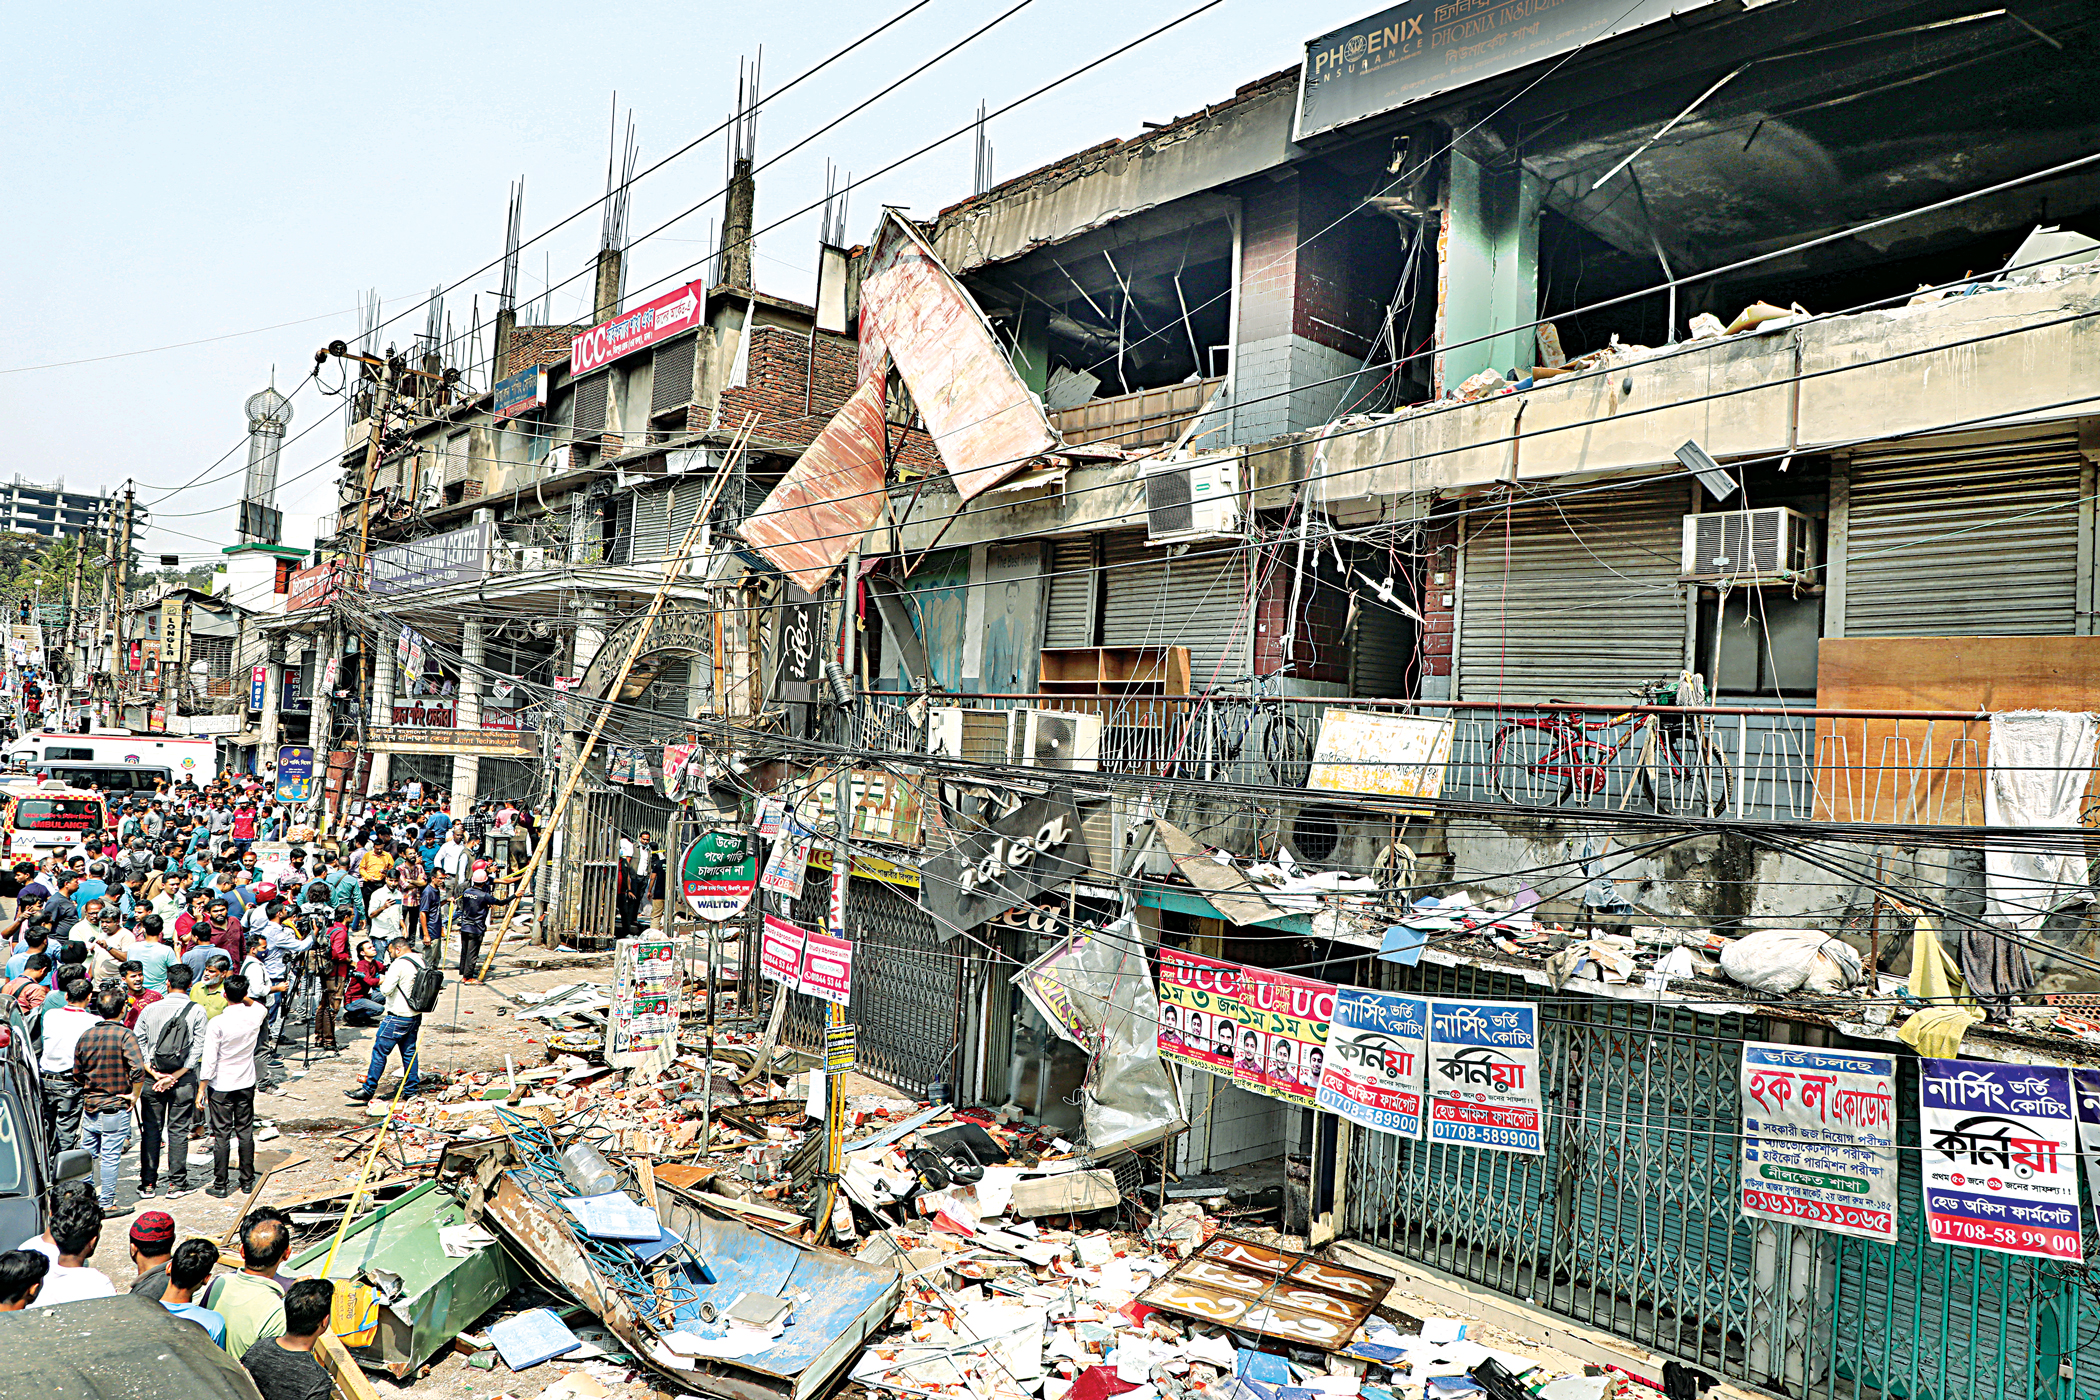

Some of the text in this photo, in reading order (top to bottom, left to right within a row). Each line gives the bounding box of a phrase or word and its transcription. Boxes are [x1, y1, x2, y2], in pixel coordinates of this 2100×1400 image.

[1315, 13, 1424, 75] PHOENIX
[1431, 13, 1496, 49] PHOENIX
[1511, 21, 1541, 41] শাখা
[1315, 39, 1422, 85] NSURANCE
[571, 326, 606, 373] UCC
[447, 528, 480, 567] CENTER
[997, 552, 1039, 569] The Best Tailors
[784, 610, 814, 678] idea
[30, 820, 89, 829] AMBULANCE
[715, 835, 742, 849] উল্টো
[958, 814, 1072, 895] idea
[698, 865, 745, 876] চালাবেন না
[704, 850, 745, 863] পথে গাড়ি
[697, 900, 738, 909] WALTON
[989, 902, 1061, 933] ea
[765, 926, 776, 936] Study
[809, 944, 821, 953] Study
[1160, 982, 1239, 1015] ১ম ৩ জন
[1275, 982, 1291, 999] ঢাবি
[1238, 1005, 1266, 1030] ১ম
[1273, 1000, 1290, 1014] সেরা
[1338, 995, 1414, 1030] নার্সিং ভর্তি
[1271, 1013, 1329, 1043] ১ম ৩
[1388, 1020, 1424, 1038] কোচিং
[1433, 1007, 1519, 1042] নার্সিং ভর্তি
[1491, 1028, 1533, 1047] কোচিং
[1335, 1033, 1415, 1078] কর্নিয়া
[1436, 1046, 1526, 1093] কর্নিয়া
[1762, 1050, 1874, 1074] ভর্তি চলছে
[1324, 1074, 1417, 1113] হেড অফিস ফার্মগেট
[1747, 1068, 1796, 1116] হক
[1832, 1081, 1892, 1130] একাডেমি
[1924, 1071, 2050, 1111] নার্সিং ভর্তি
[1321, 1091, 1416, 1131] 01708-589900
[1435, 1103, 1535, 1128] হেড অফিস ফার্মগেট
[2010, 1096, 2071, 1118] কোচিং
[1435, 1122, 1537, 1148] 01708-589900
[1763, 1122, 1798, 1137] সহকারী
[1800, 1128, 1819, 1140] জজ
[1822, 1128, 1854, 1143] নিয়োগ
[1843, 1147, 1876, 1163] পরীক্ষা
[1929, 1115, 2060, 1179] কর্নিয়া
[1763, 1149, 1884, 1178] হাইকোর্ট পারমিশন পরীক্ষা
[1768, 1165, 1862, 1193] নীলক্ষেত শাখা
[1785, 1185, 1801, 1196] সুপার
[1931, 1172, 1949, 1181] প্রথম
[1951, 1176, 1965, 1184] ৫০
[1967, 1177, 1985, 1186] জনে
[2004, 1181, 2028, 1191] জনের
[1746, 1192, 1890, 1232] ০১৬১৮৯১১০৬৫
[1931, 1195, 2073, 1224] হেড অফিস ফার্মগেট
[1931, 1218, 2077, 1252] 01708-58 99 00
